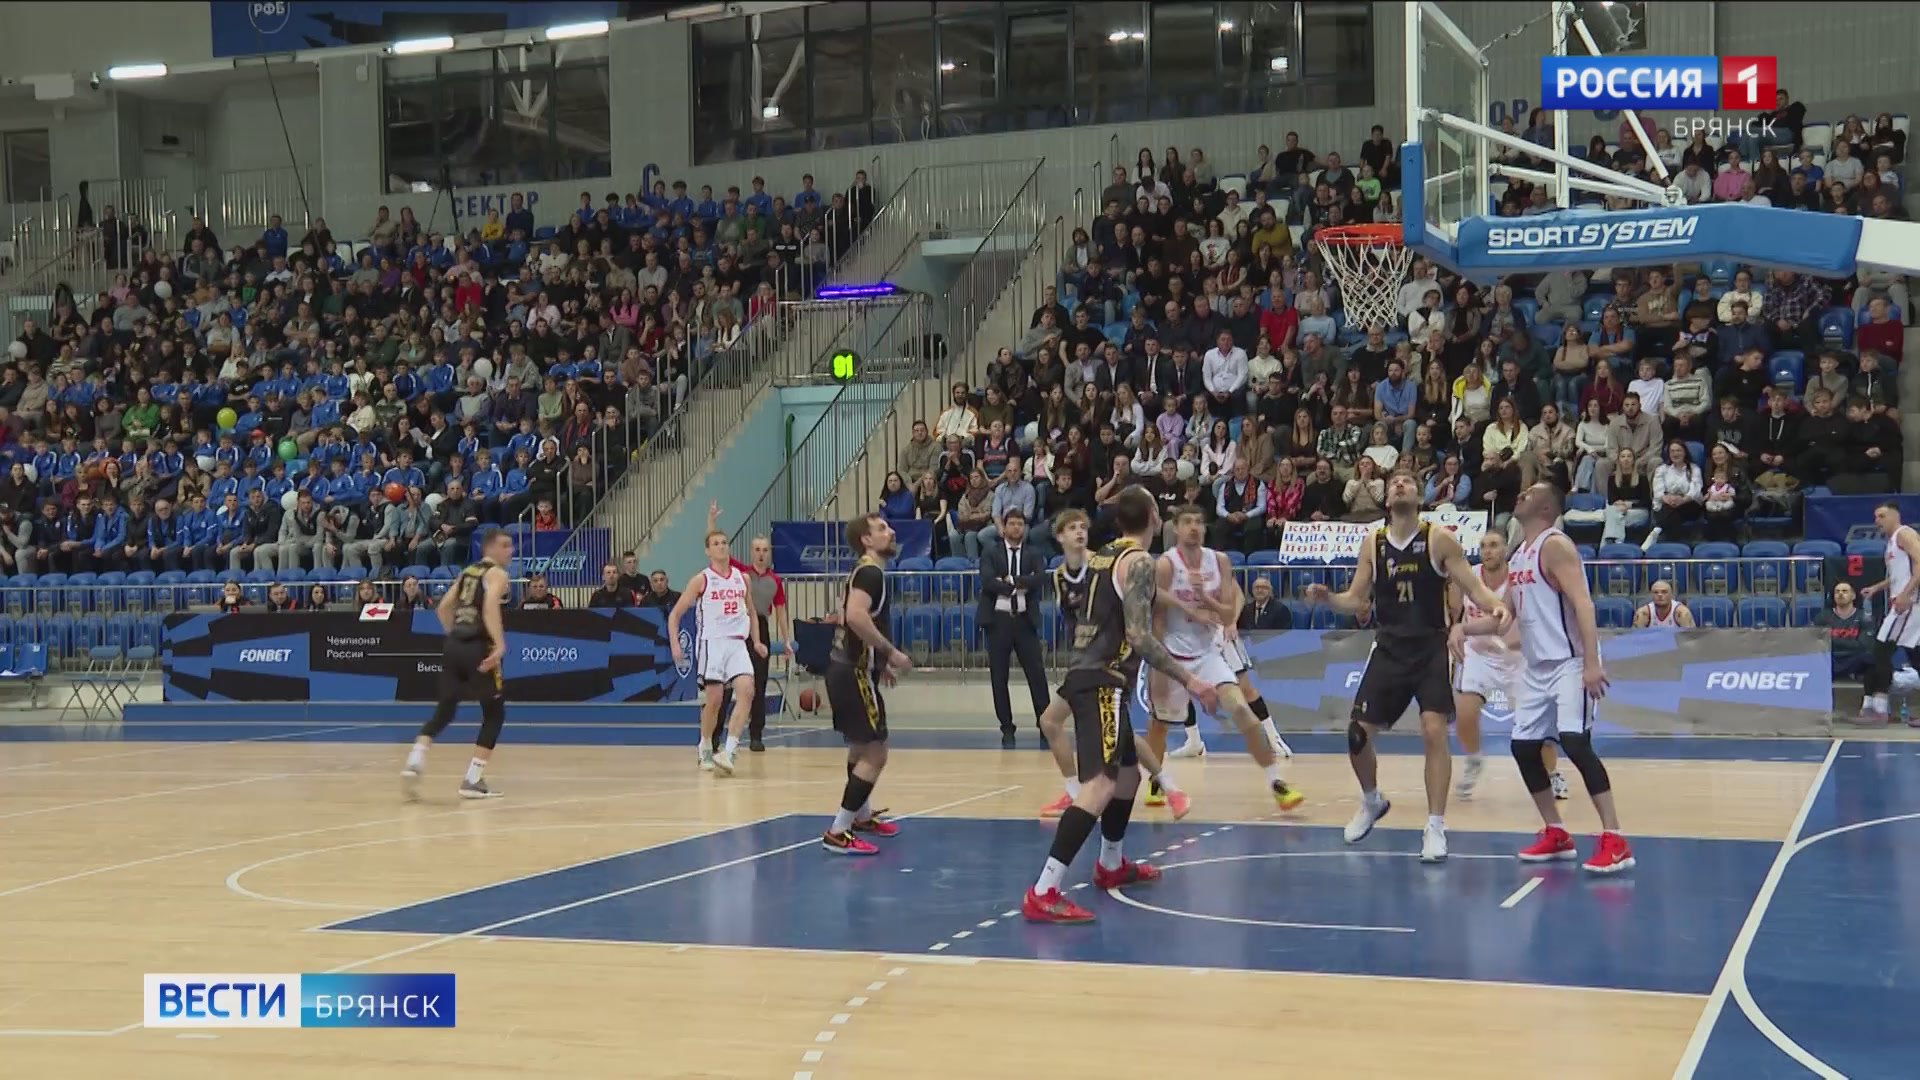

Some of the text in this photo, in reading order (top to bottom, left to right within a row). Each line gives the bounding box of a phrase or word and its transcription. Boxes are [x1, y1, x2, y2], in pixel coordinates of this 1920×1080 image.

[453, 191, 539, 218] СЕКТР
[1288, 523, 1370, 534] КОМАНДА
[1284, 533, 1367, 544] НАША СИЛ
[1284, 543, 1354, 554] ПОБЕДА
[710, 588, 745, 600] ДЕСН
[1396, 580, 1414, 602] 21
[723, 601, 739, 614] 22
[326, 635, 381, 646] Чемпионат
[239, 649, 292, 662] FONBET
[326, 650, 364, 659] России
[521, 647, 578, 662] 2025/26
[1705, 670, 1810, 691] FONBET
